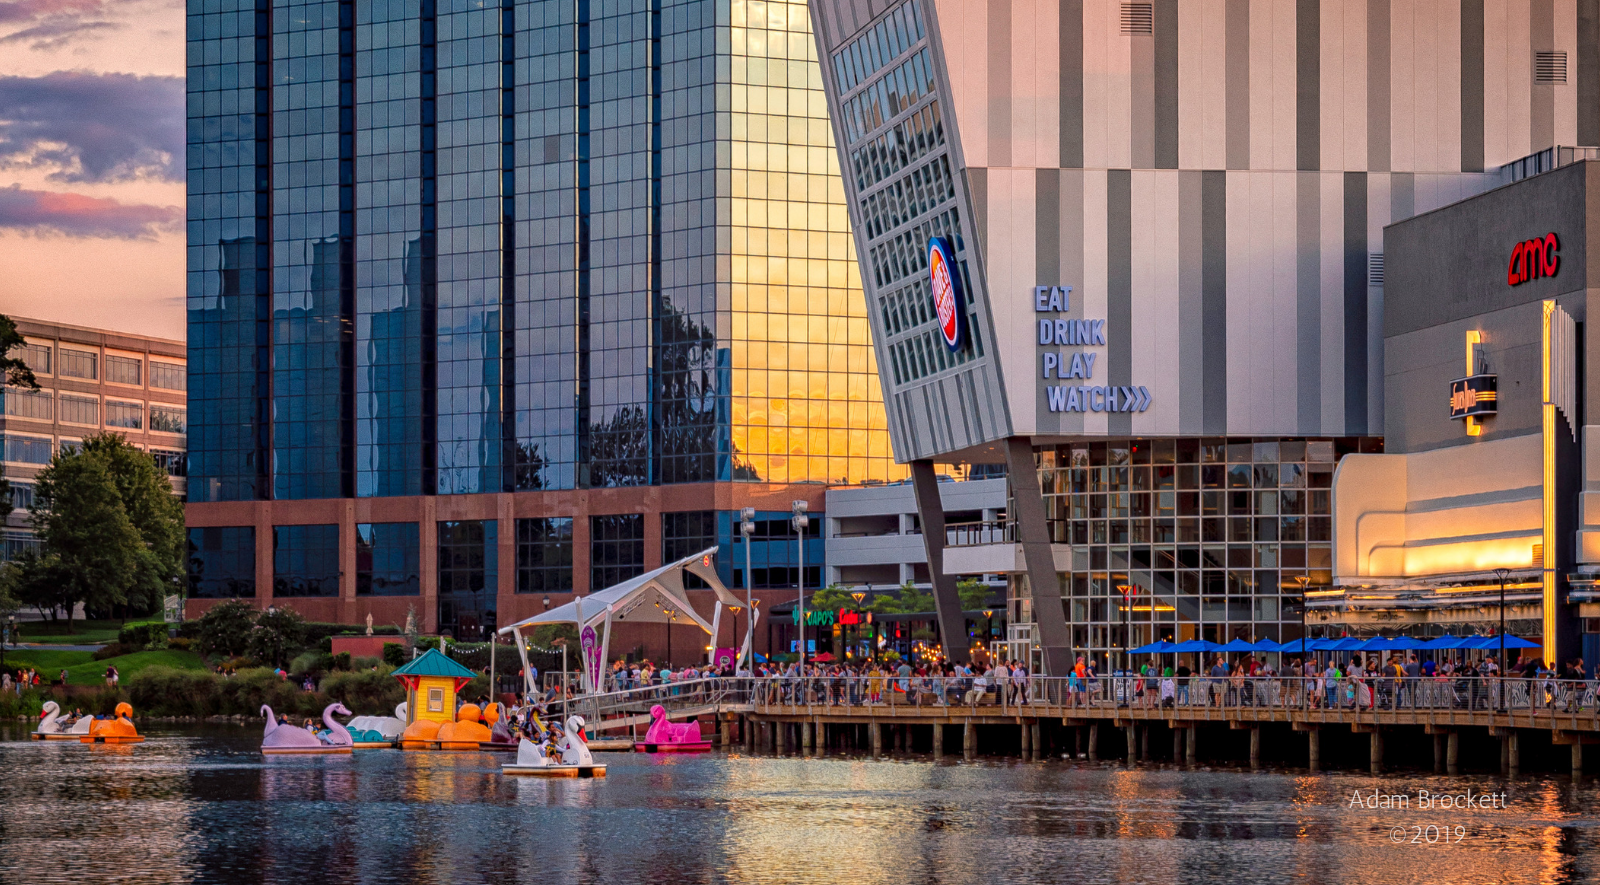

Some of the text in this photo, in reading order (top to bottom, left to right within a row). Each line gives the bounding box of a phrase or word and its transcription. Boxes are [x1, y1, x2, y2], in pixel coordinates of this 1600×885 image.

[1035, 285, 1073, 312] EAT
[1039, 319, 1106, 346] DRINK
[1043, 352, 1097, 379] PLAY
[1046, 385, 1118, 413] WATCH
